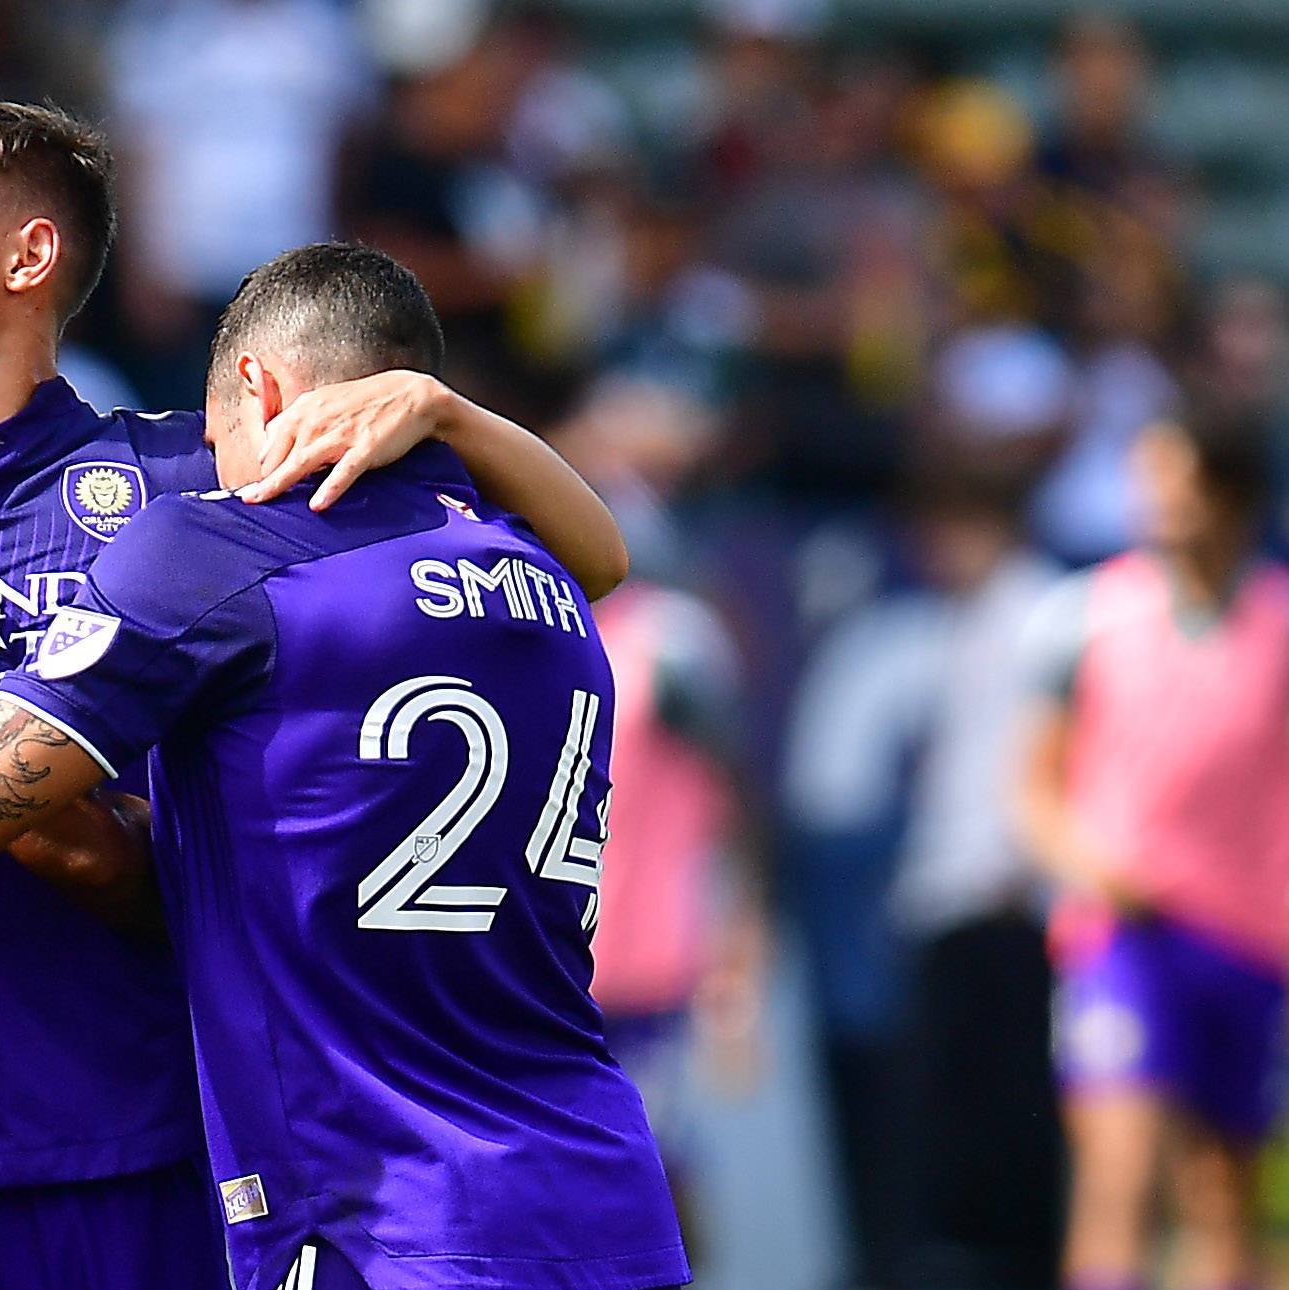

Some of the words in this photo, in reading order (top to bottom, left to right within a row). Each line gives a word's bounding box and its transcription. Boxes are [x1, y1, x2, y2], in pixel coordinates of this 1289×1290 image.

[96, 524, 118, 532] CITY
[410, 557, 587, 639] SMITH
[358, 675, 613, 931] 24
